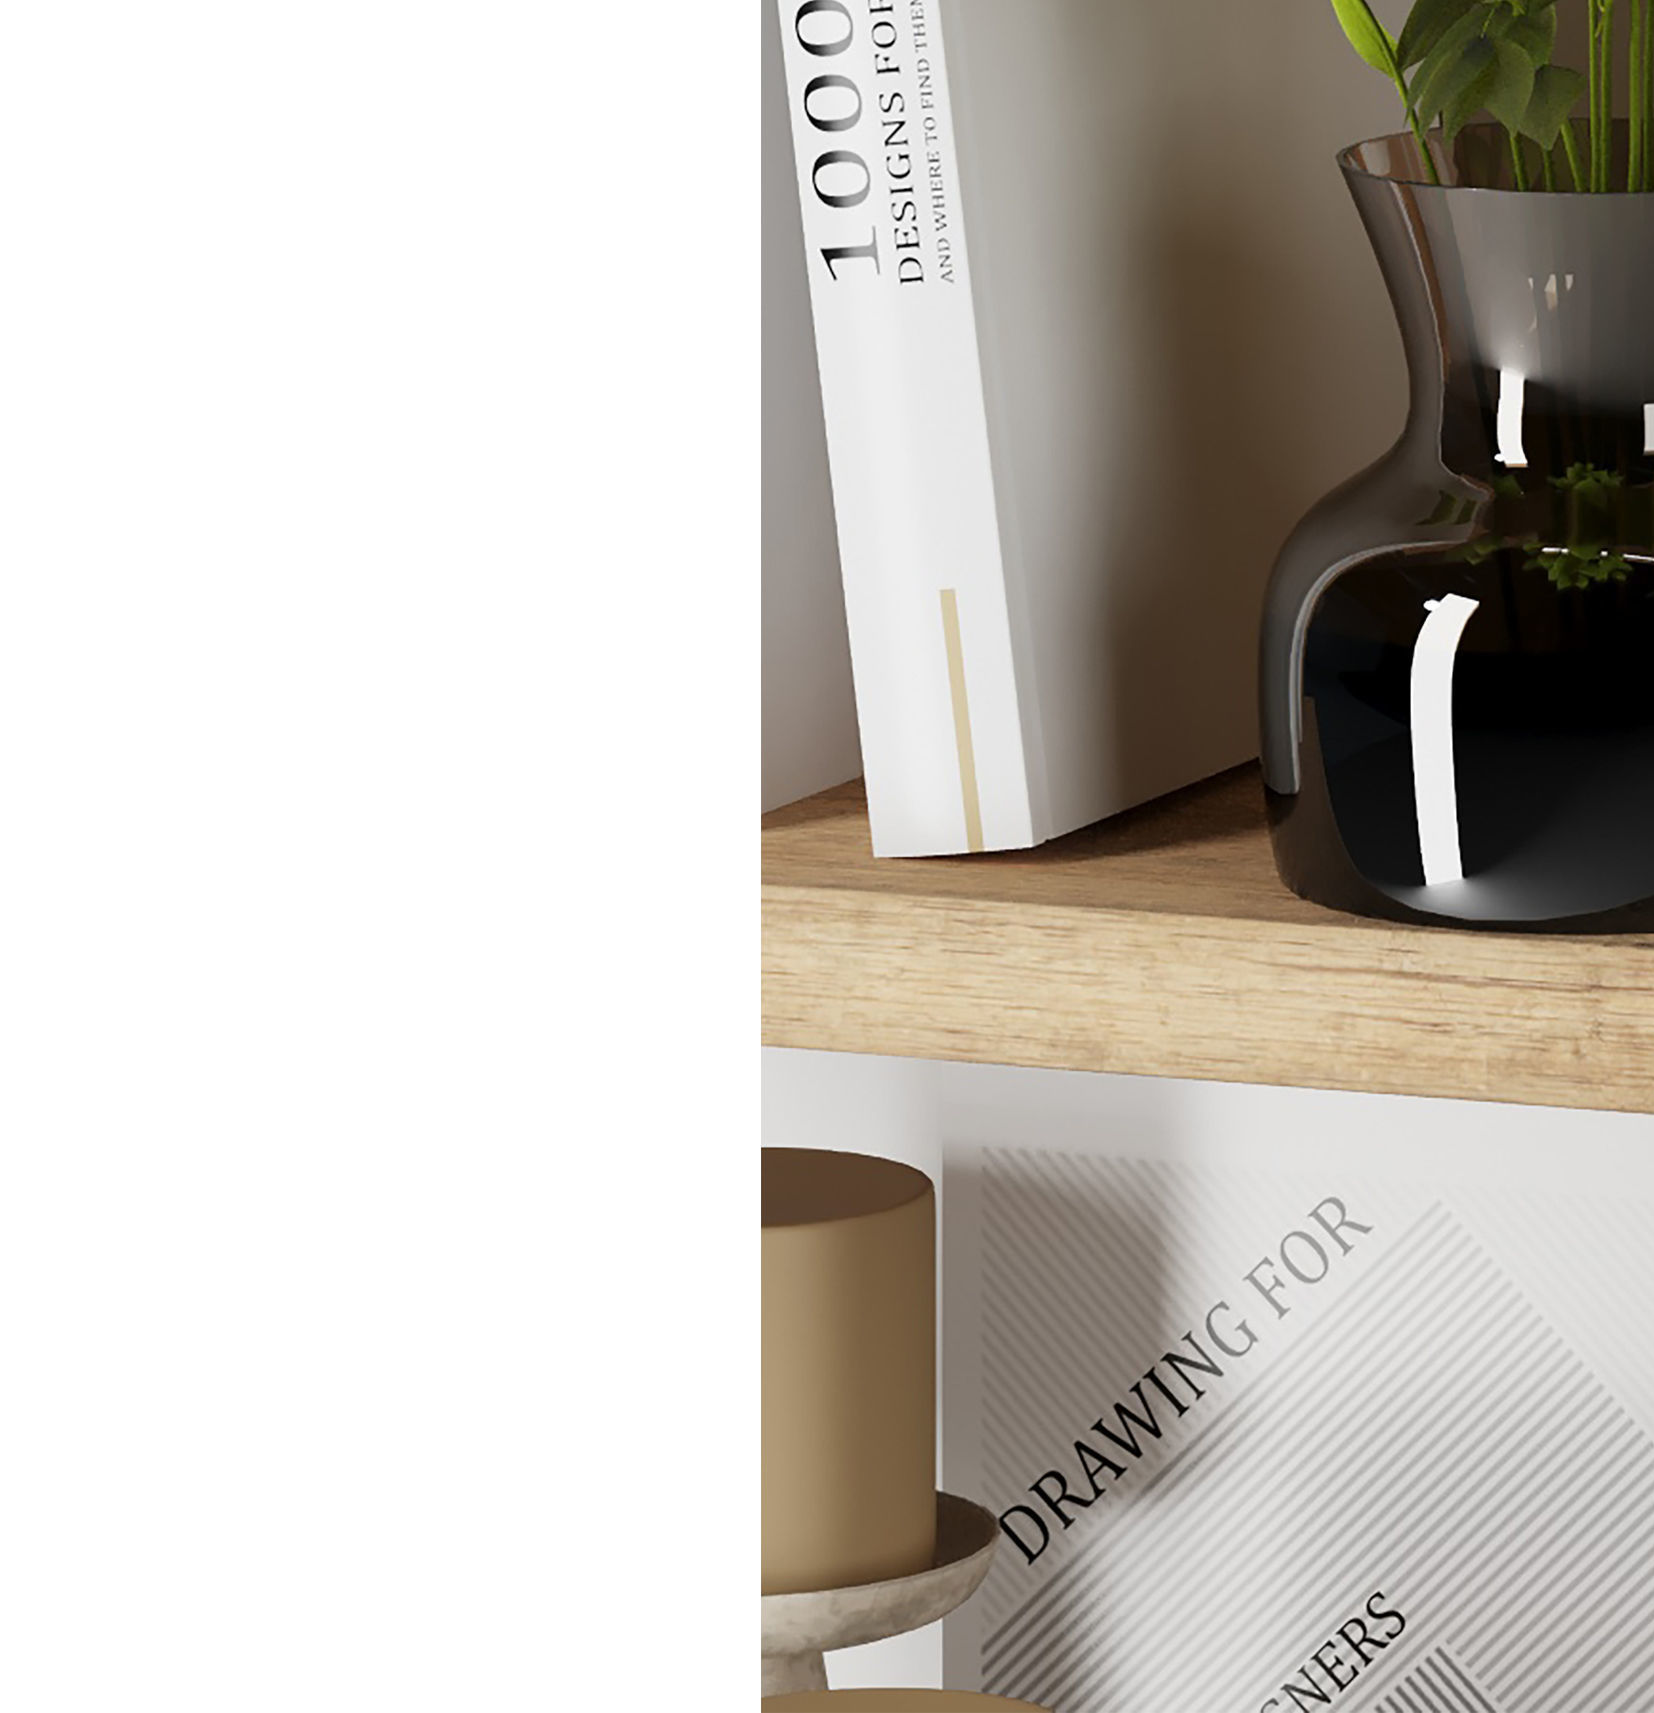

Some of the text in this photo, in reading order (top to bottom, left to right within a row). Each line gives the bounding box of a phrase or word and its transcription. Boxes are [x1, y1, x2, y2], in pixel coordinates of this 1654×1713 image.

[916, 58, 935, 109] FIND
[923, 116, 938, 147] TO
[878, 91, 925, 286] DESIGNS
[928, 150, 949, 232] WHERE
[939, 238, 955, 284] AND
[997, 1195, 1374, 1566] DRAWING FOR
[1260, 1591, 1406, 1713] NERS
